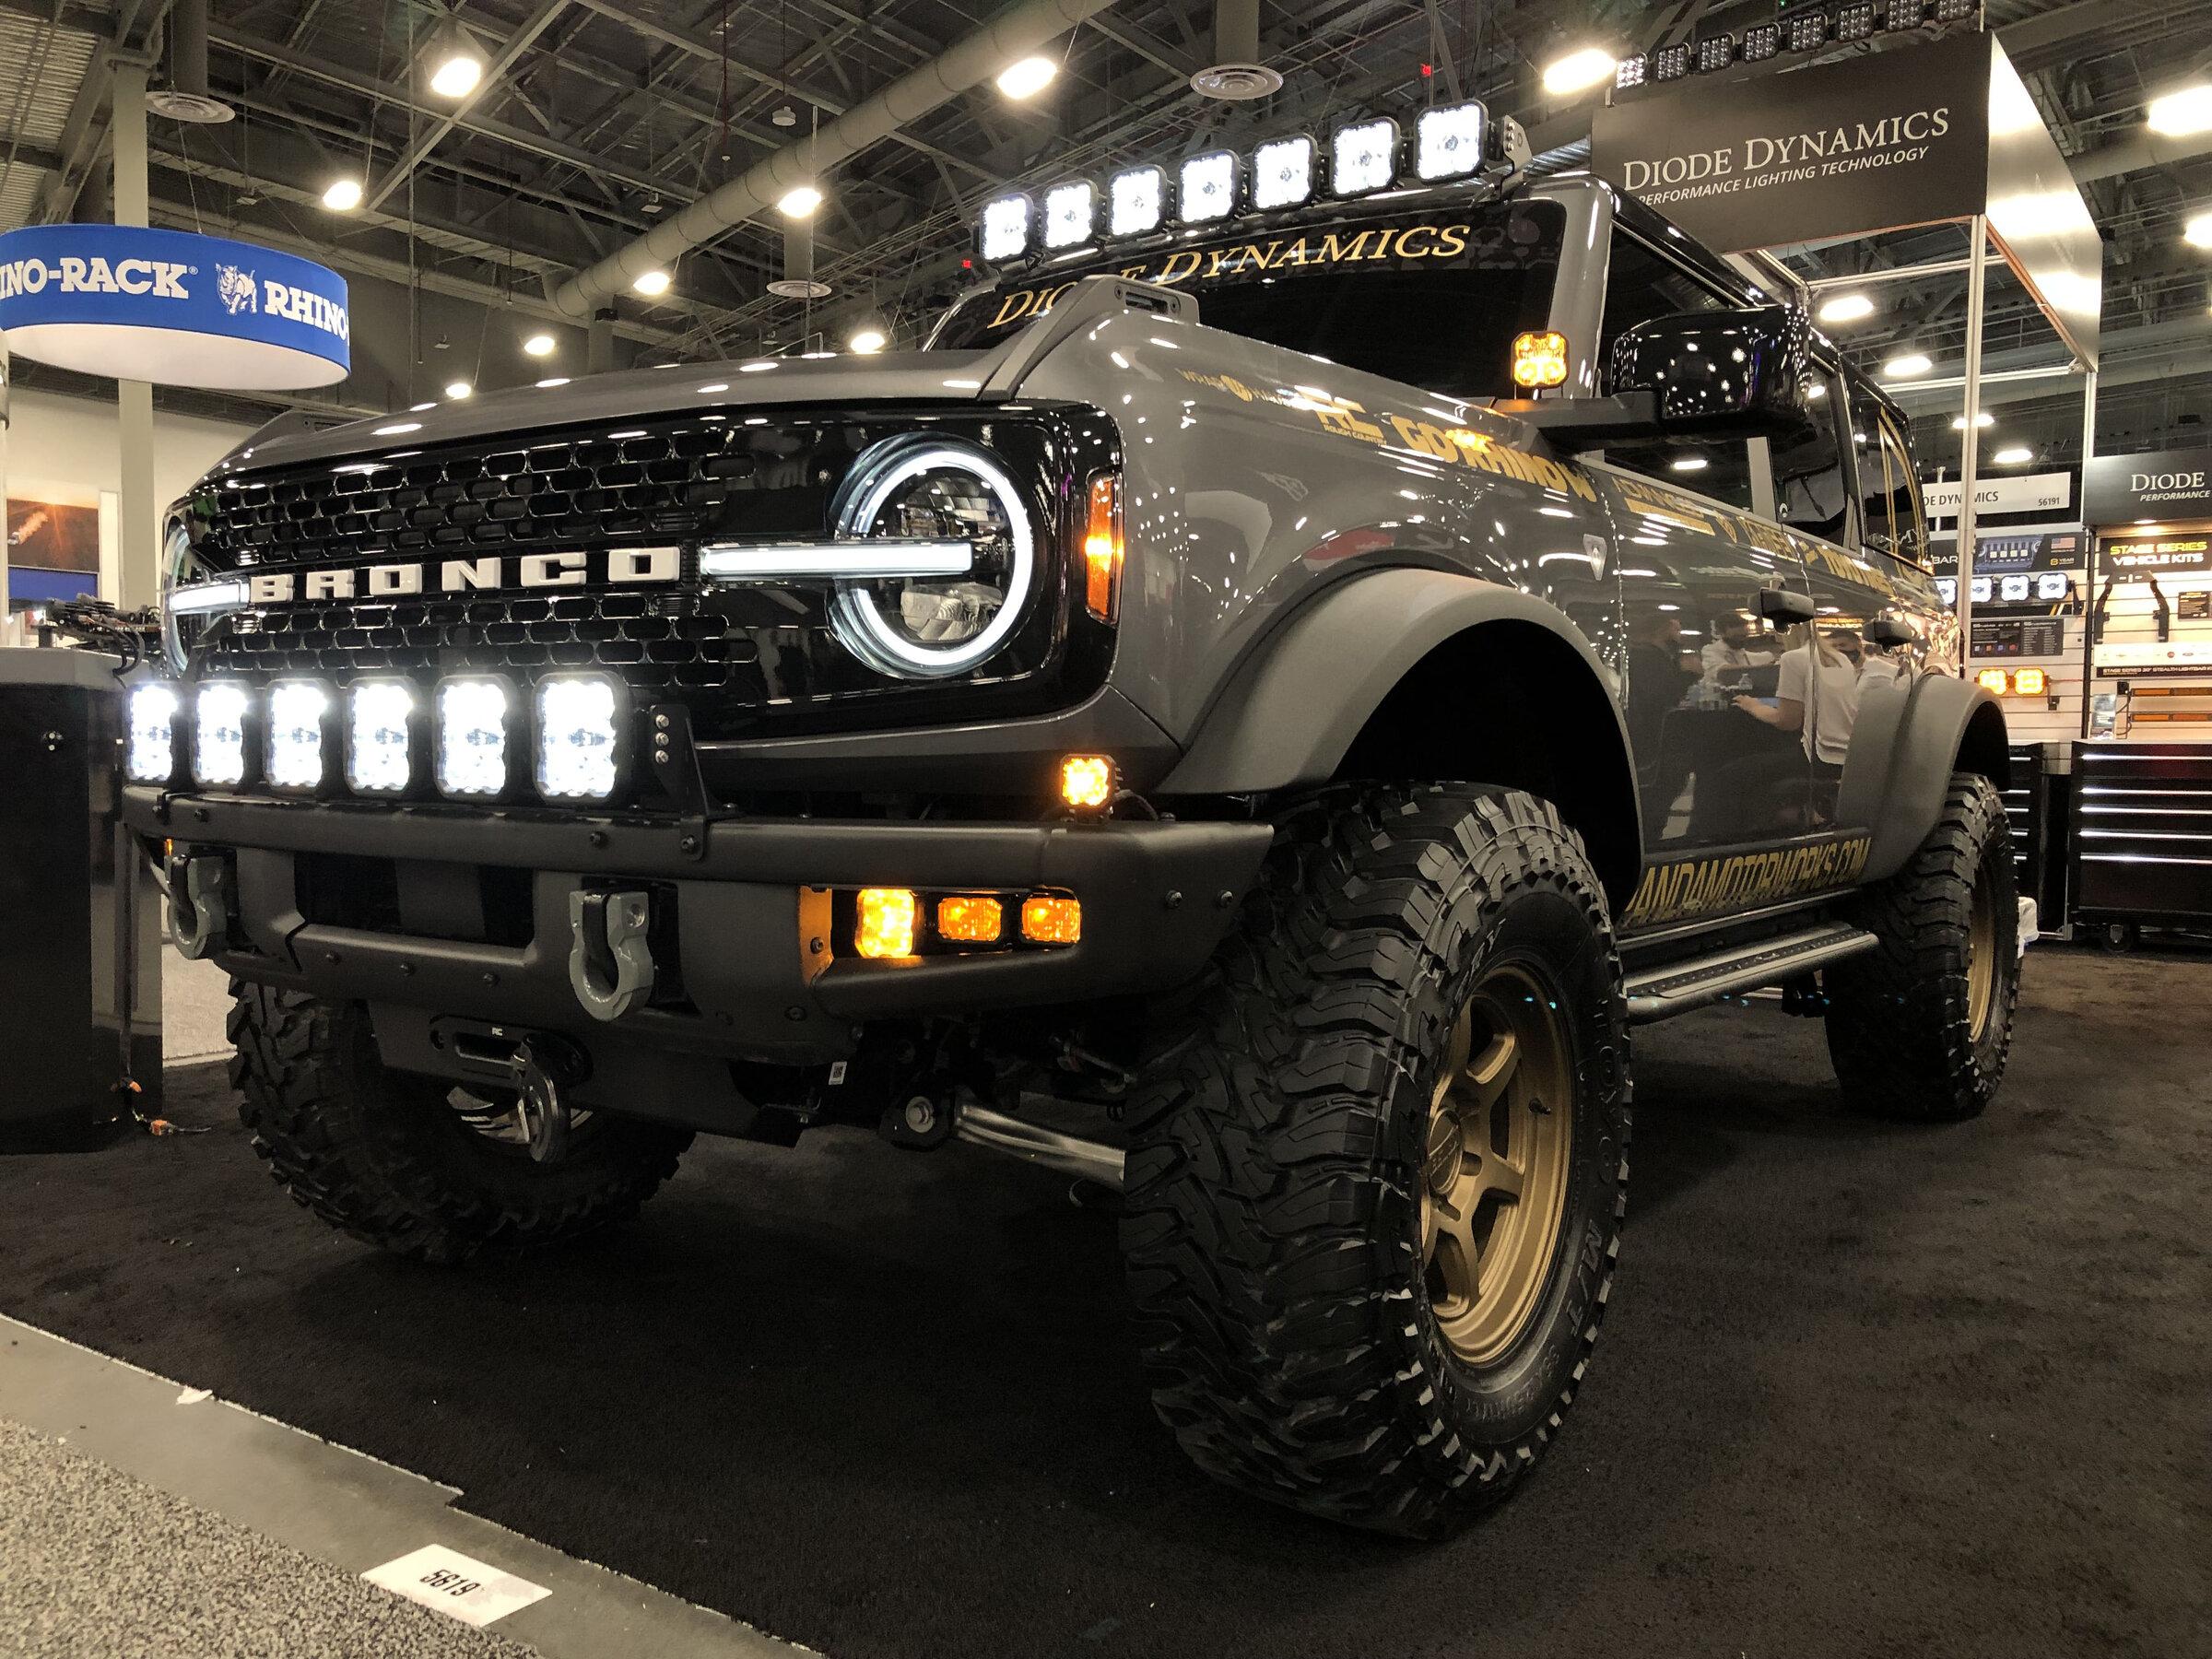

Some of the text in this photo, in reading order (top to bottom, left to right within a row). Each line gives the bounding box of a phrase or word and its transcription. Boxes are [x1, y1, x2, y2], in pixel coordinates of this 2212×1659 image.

[1623, 107, 1949, 192] DIODE DYNAMICS
[1638, 146, 1930, 206] PERFORMANCE LIGHTING TECHNOLOGY
[987, 225, 1471, 329] DIOE DYNAMICS
[264, 279, 349, 347] RHINO-
[2130, 472, 2206, 491] DIODE
[2139, 489, 2211, 501] PERFORMANCE
[1939, 491, 1999, 506] DYNMICS
[2038, 498, 2060, 507] 56191
[2110, 541, 2208, 555] STAGE SERIES
[2171, 553, 2205, 563] KITS
[250, 546, 681, 605] BRONCO
[1625, 836, 1872, 915] ANDAMOTORWORKS.COM
[419, 1569, 482, 1596] 5619
